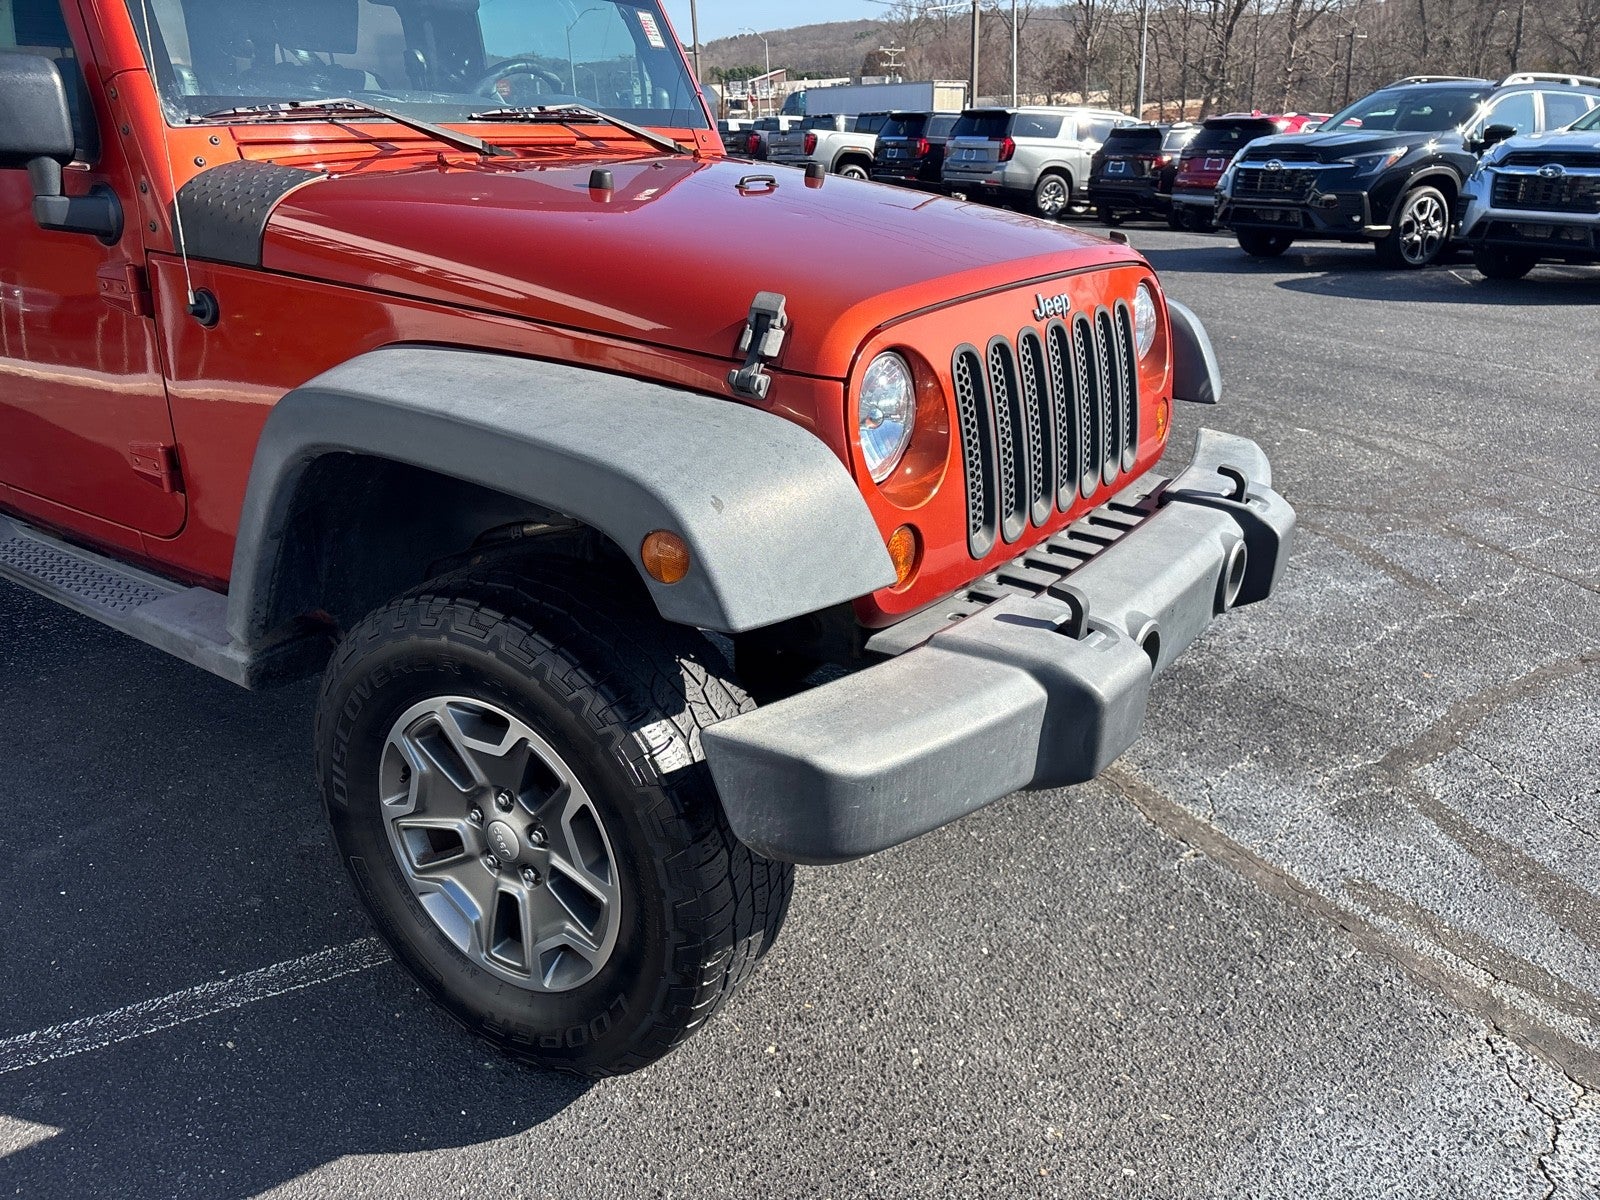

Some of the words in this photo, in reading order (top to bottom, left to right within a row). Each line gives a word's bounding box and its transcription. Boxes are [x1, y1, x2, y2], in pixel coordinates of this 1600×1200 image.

[1032, 292, 1071, 322] Jeep
[332, 653, 462, 807] DISCOVERER
[493, 826, 511, 857] Jeep
[481, 993, 628, 1049] COOPER
